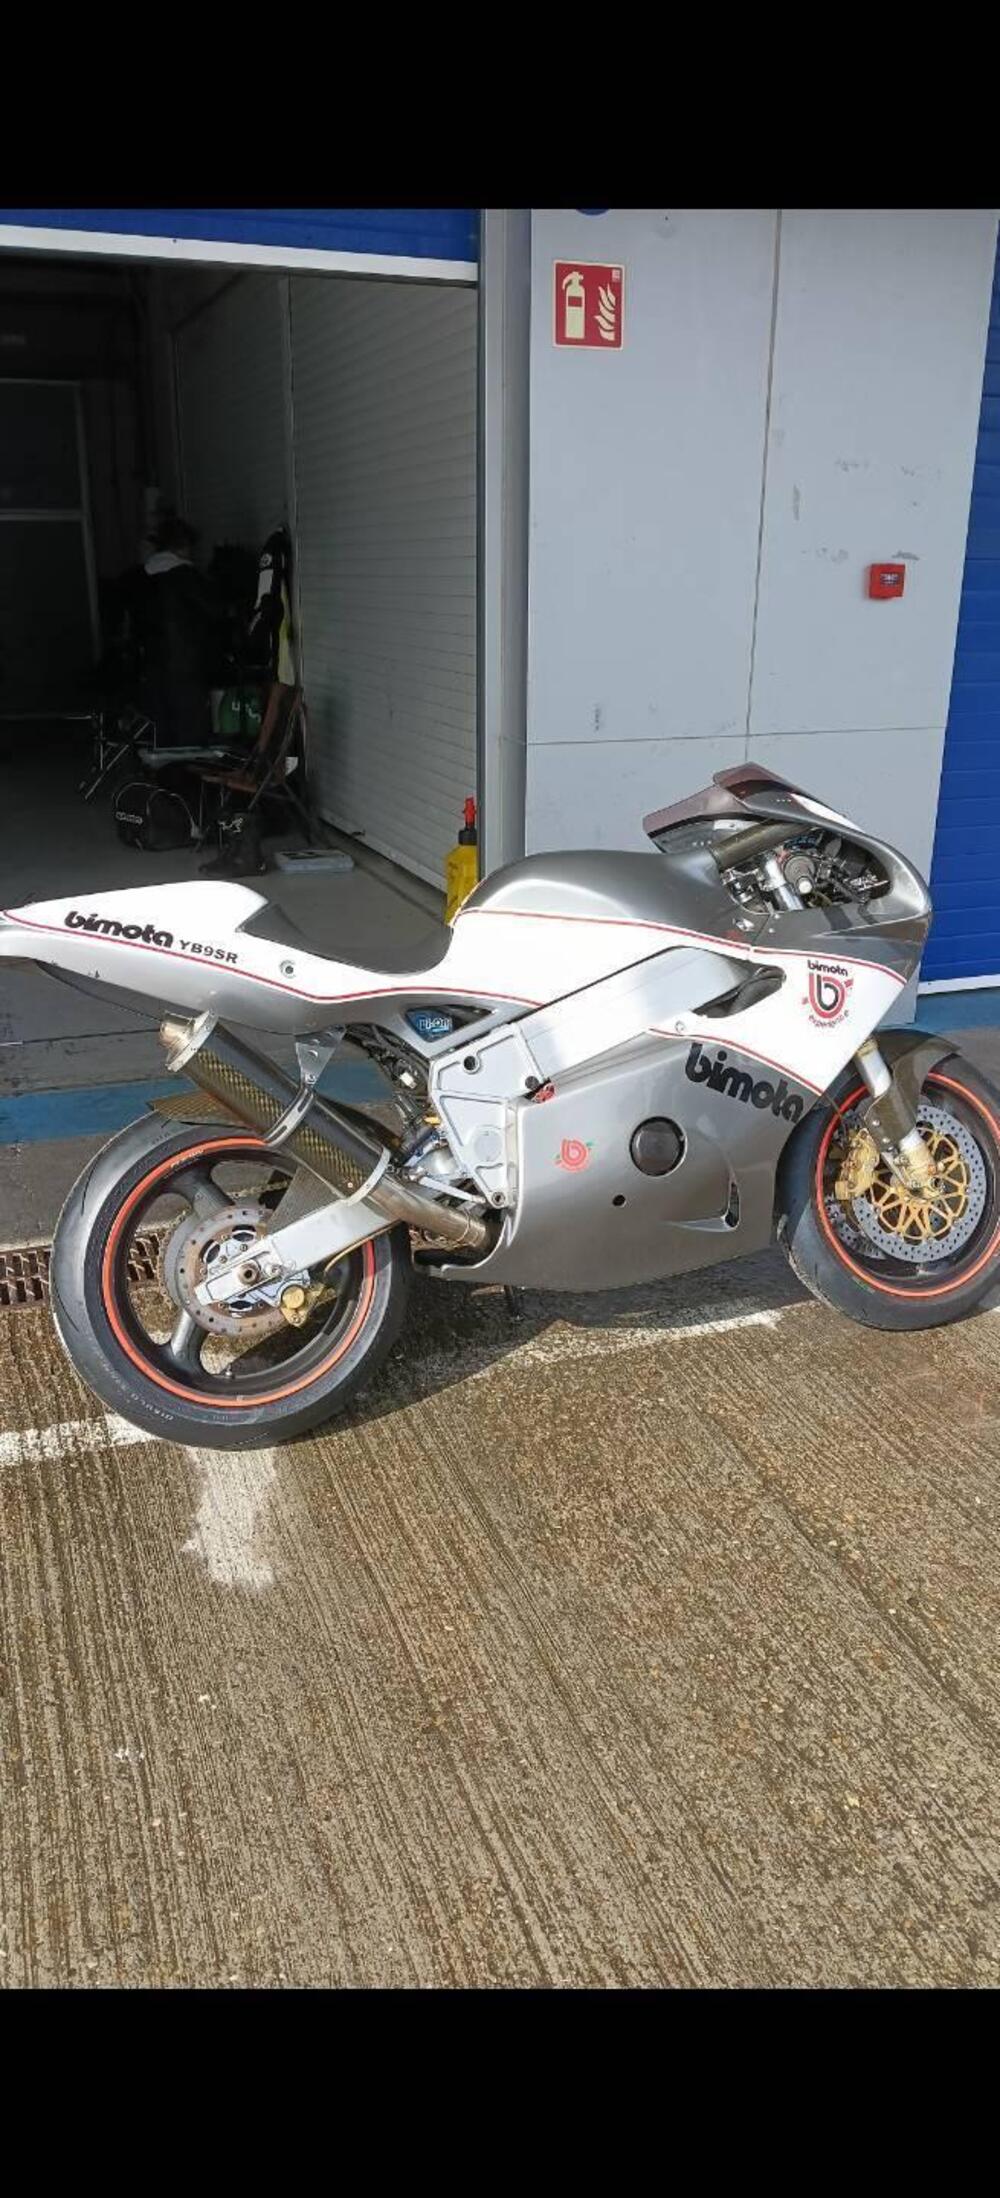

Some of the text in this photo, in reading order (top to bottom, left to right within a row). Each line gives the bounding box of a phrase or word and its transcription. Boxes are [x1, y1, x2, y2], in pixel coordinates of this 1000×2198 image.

[64, 911, 238, 964] bimota YB9SR
[807, 959, 849, 977] bimota
[685, 1042, 804, 1123] bimota
